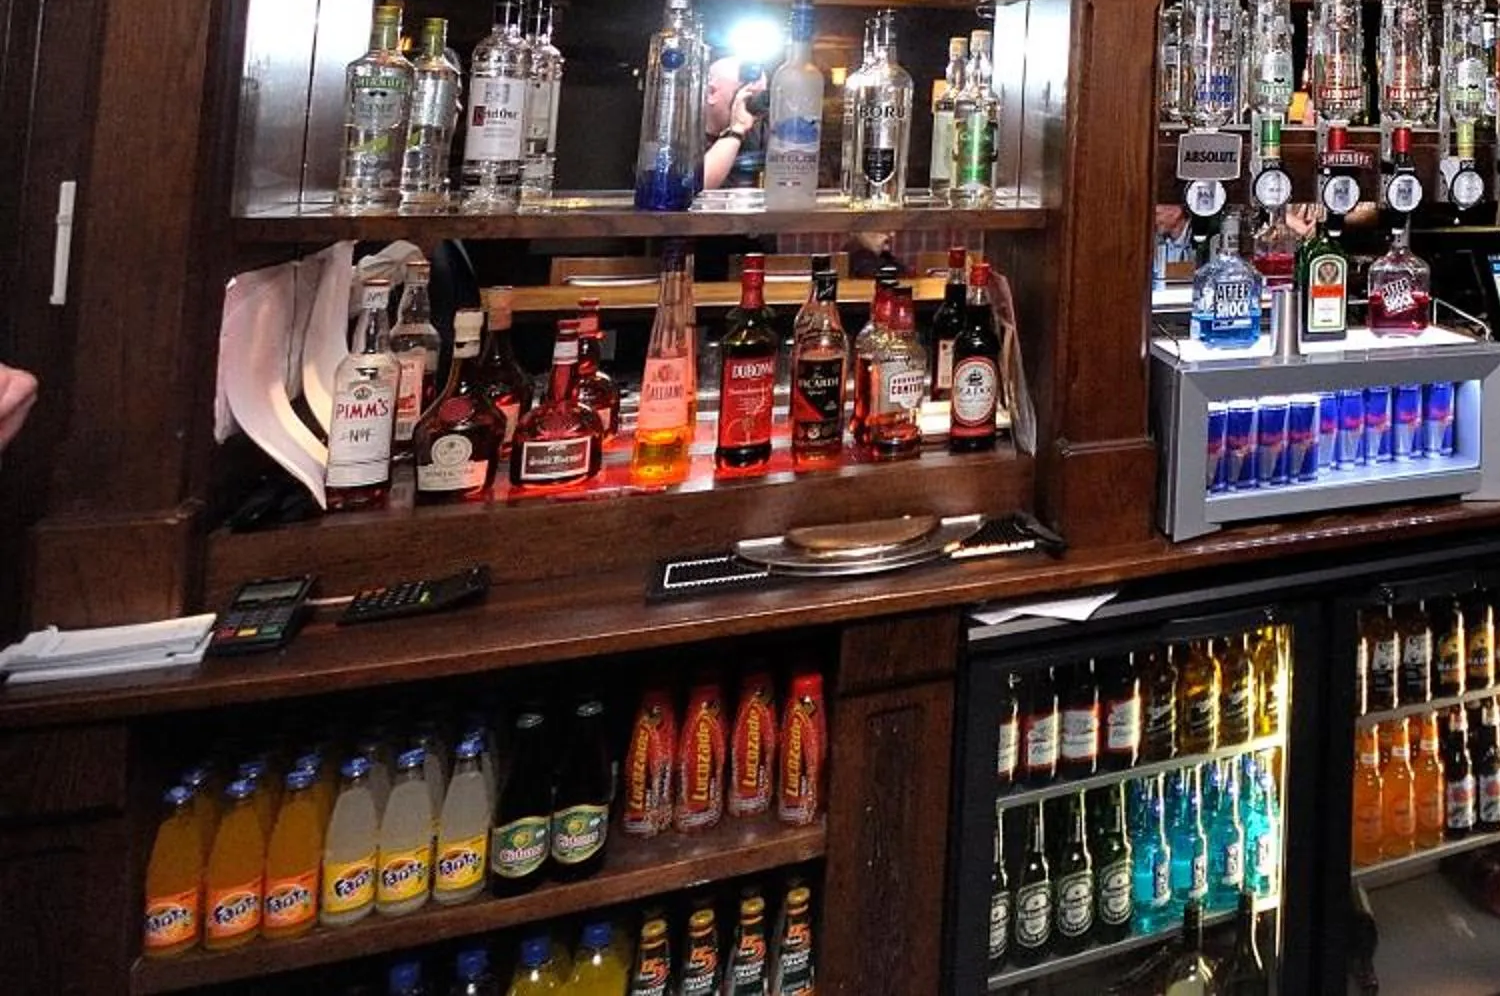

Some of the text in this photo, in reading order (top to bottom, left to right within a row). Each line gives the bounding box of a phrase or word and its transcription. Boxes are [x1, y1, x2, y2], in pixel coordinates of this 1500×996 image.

[335, 398, 389, 420] PIMM'S
[629, 720, 651, 811] Lucozade
[691, 718, 711, 802] Lucozade
[742, 707, 762, 788] Lucozade
[785, 712, 802, 796] Lucozade
